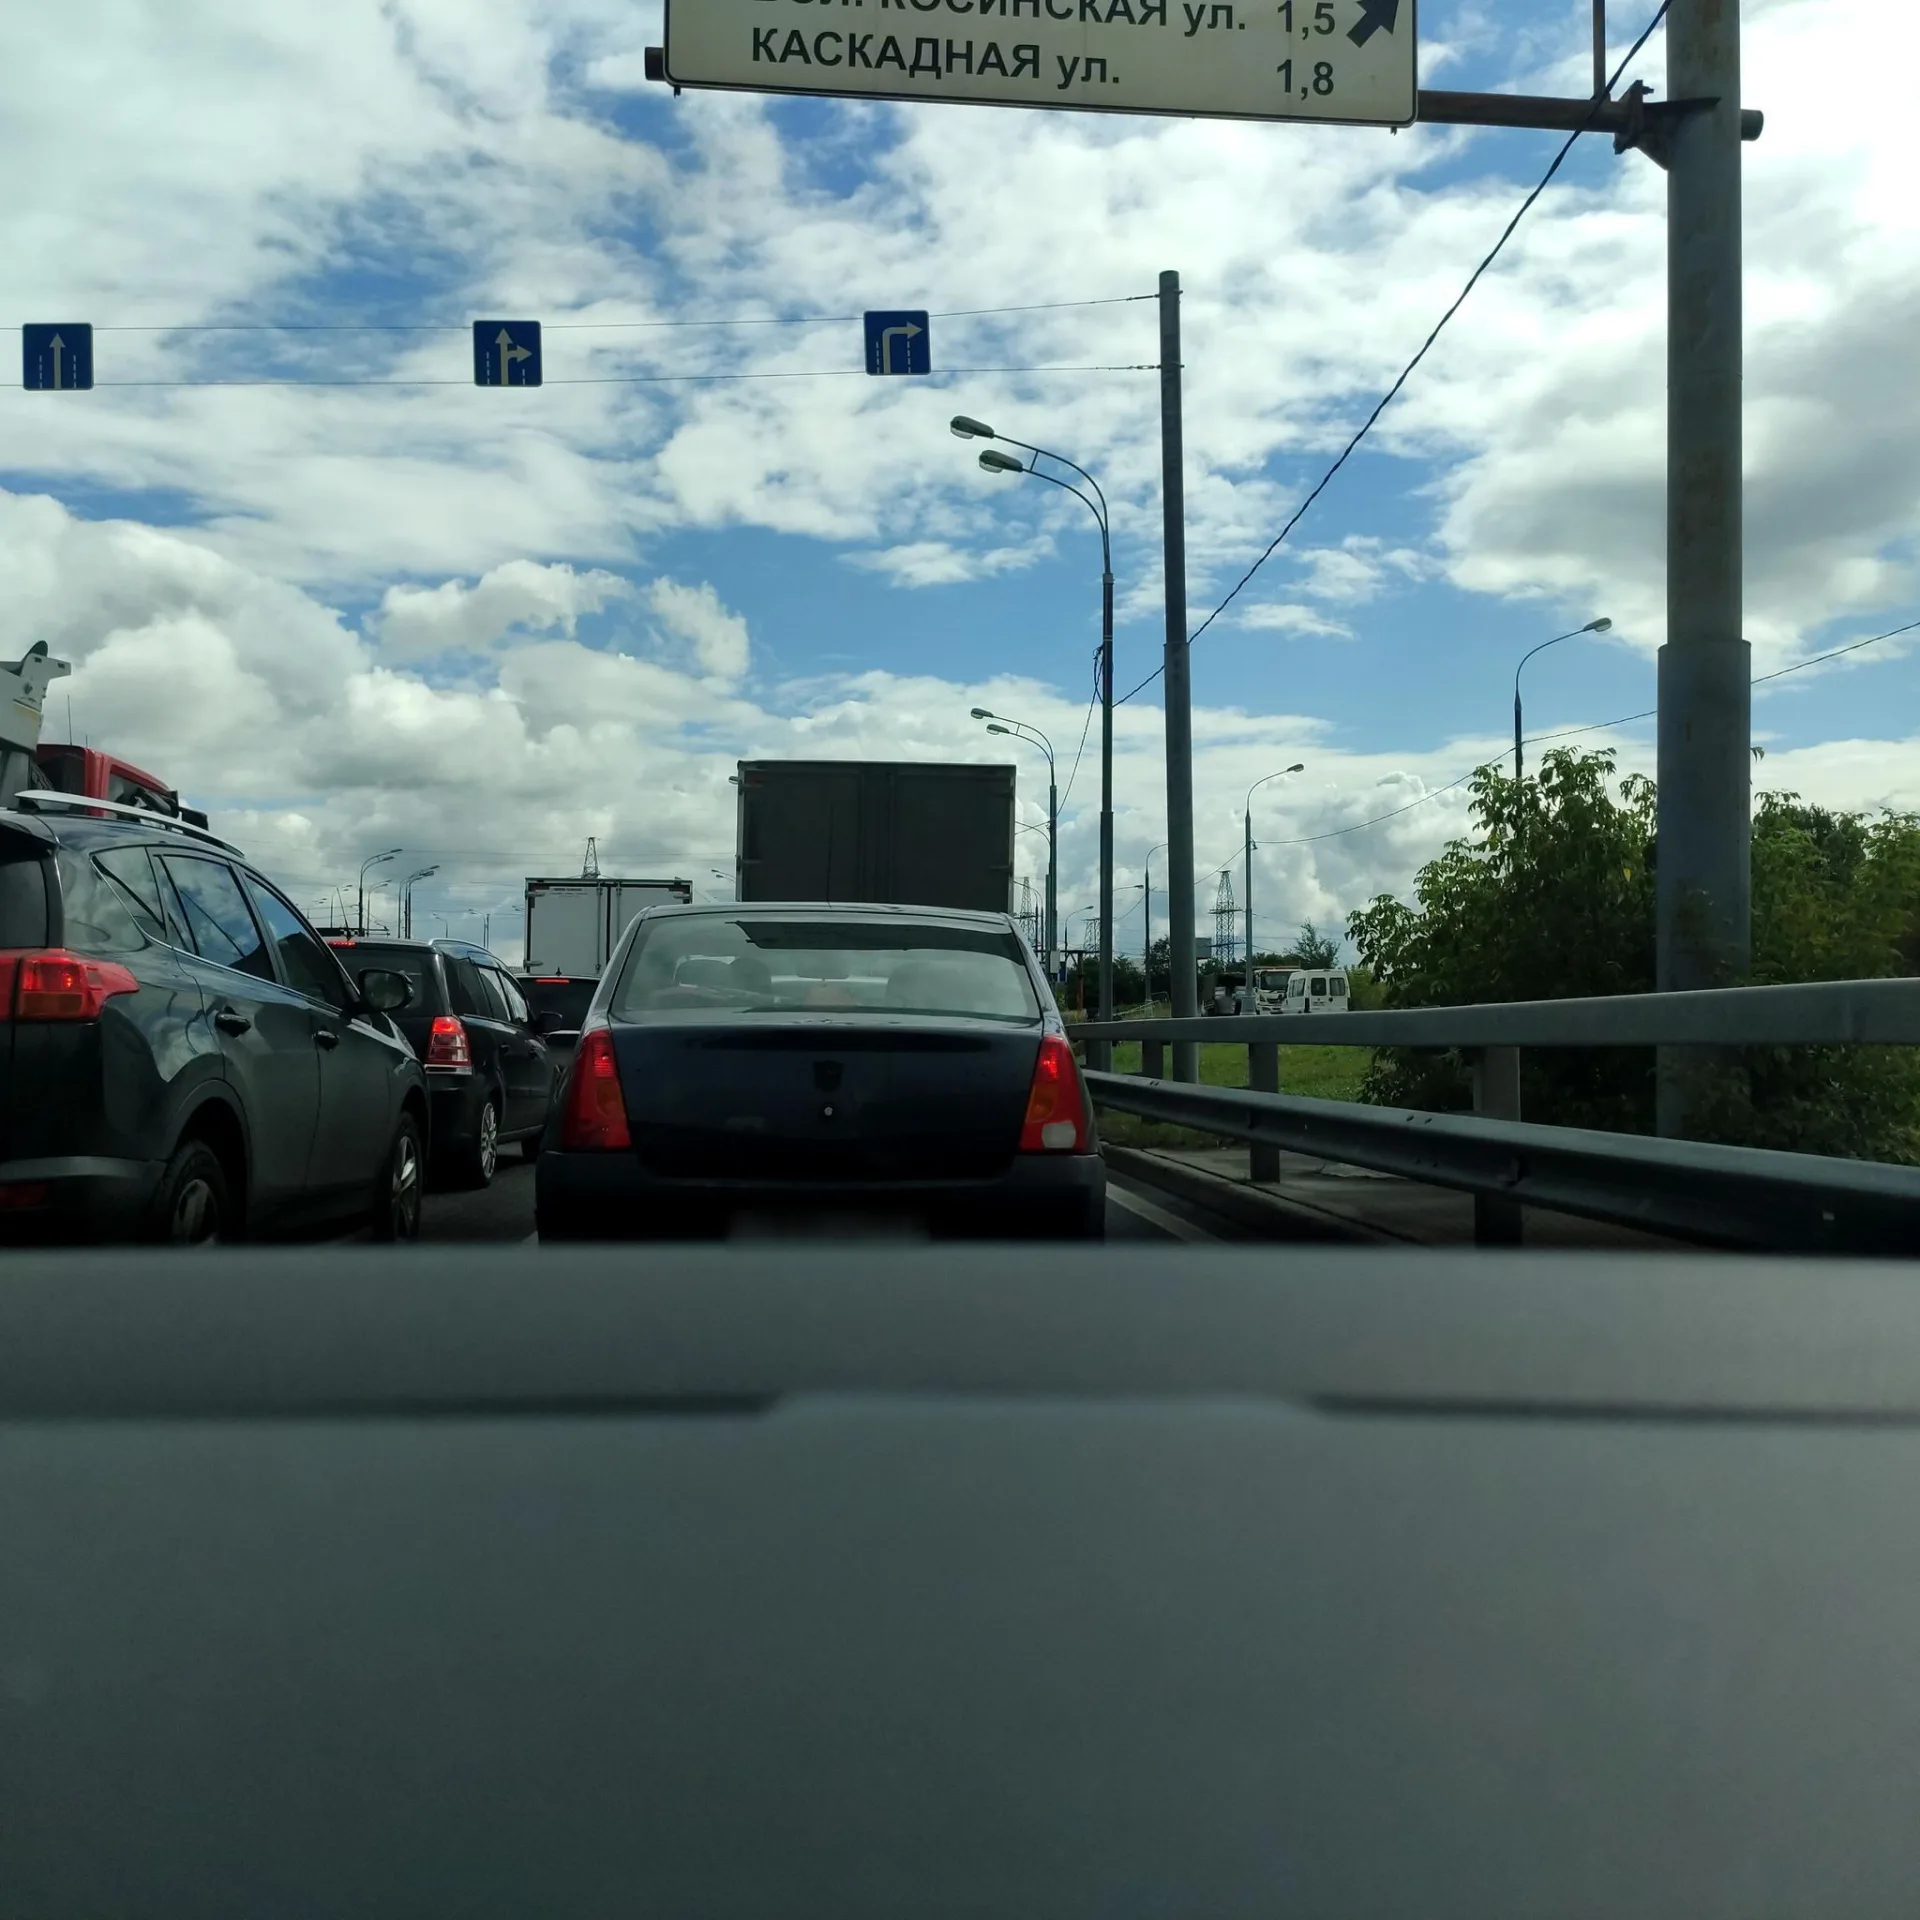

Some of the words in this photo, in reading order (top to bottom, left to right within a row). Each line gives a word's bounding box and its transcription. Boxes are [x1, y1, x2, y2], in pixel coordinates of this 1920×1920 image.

[881, 0, 1167, 26] НСКАЯ
[1182, 3, 1246, 37] ул.
[1277, 0, 1336, 40] 1,5
[752, 27, 1040, 79] КАСКАДНАЯ
[1056, 55, 1120, 90] ул.
[1276, 59, 1335, 100] 1,8
